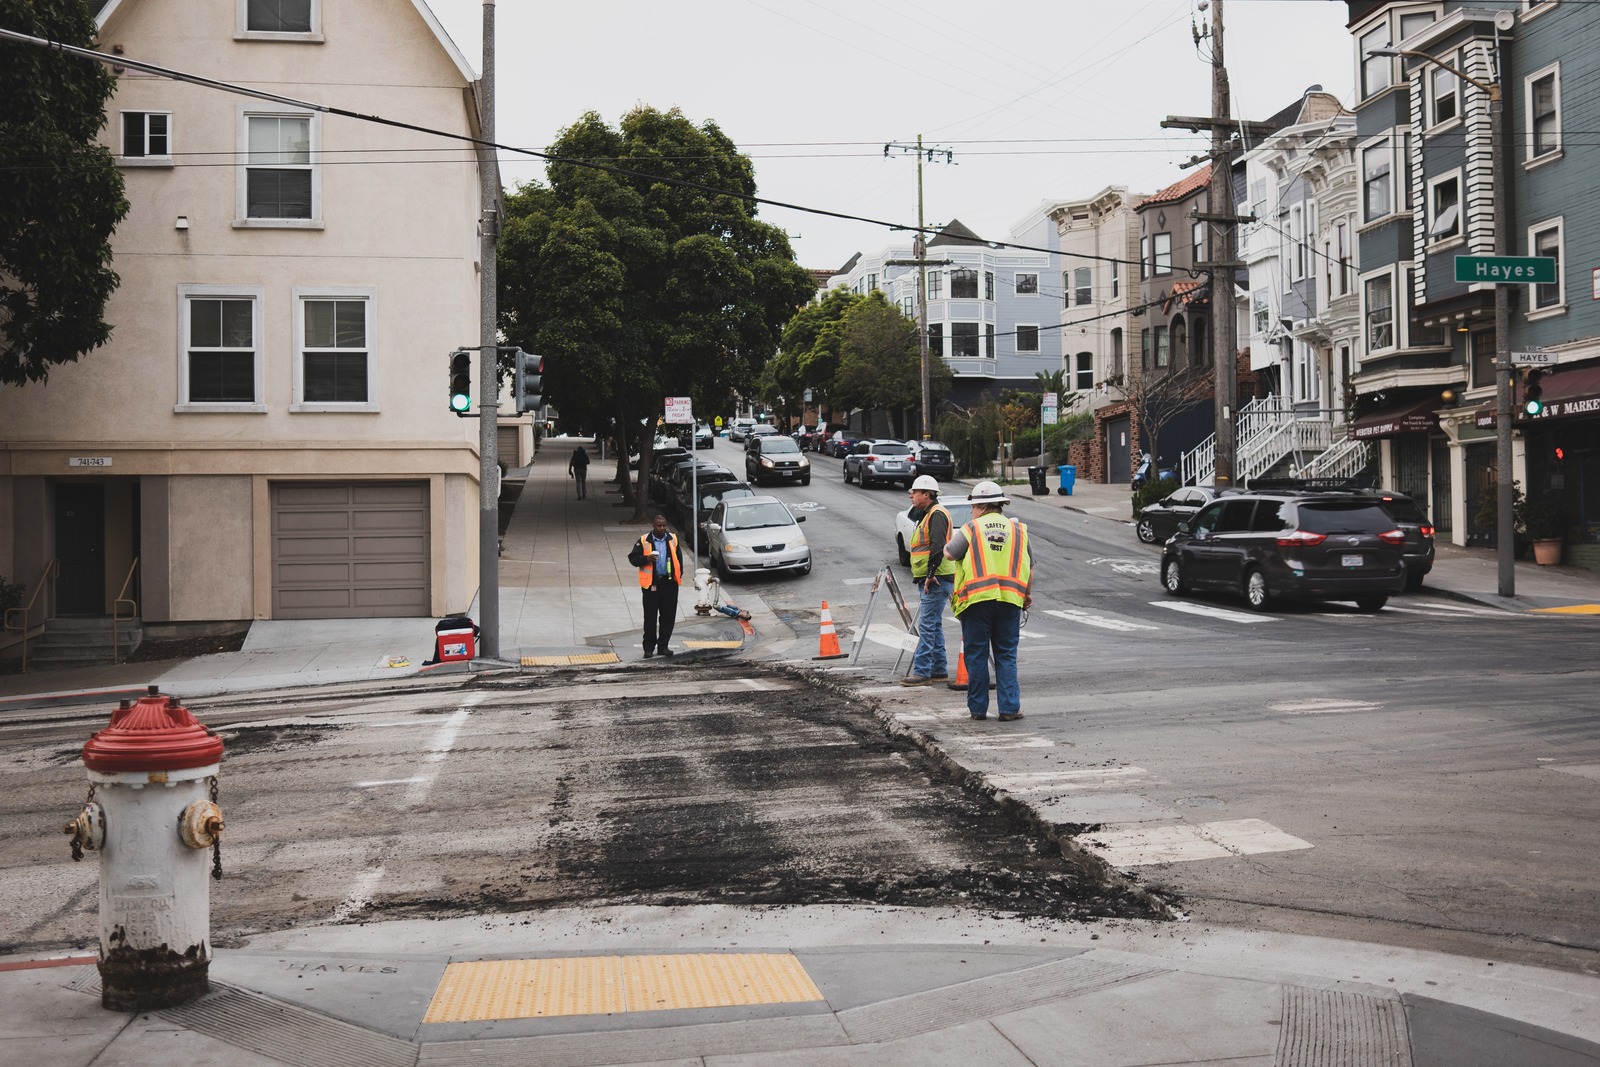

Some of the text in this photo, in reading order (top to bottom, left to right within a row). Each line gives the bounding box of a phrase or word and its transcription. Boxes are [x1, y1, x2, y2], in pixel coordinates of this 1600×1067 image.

[1475, 262, 1536, 280] Hayes
[1520, 354, 1549, 362] HAYES
[1550, 404, 1560, 416] W
[1356, 427, 1373, 437] WEBSTER
[1380, 423, 1393, 434] SUPPLY
[78, 458, 104, 466] 741-743
[984, 522, 1006, 530] SAFETY
[286, 963, 399, 974] HAYES
